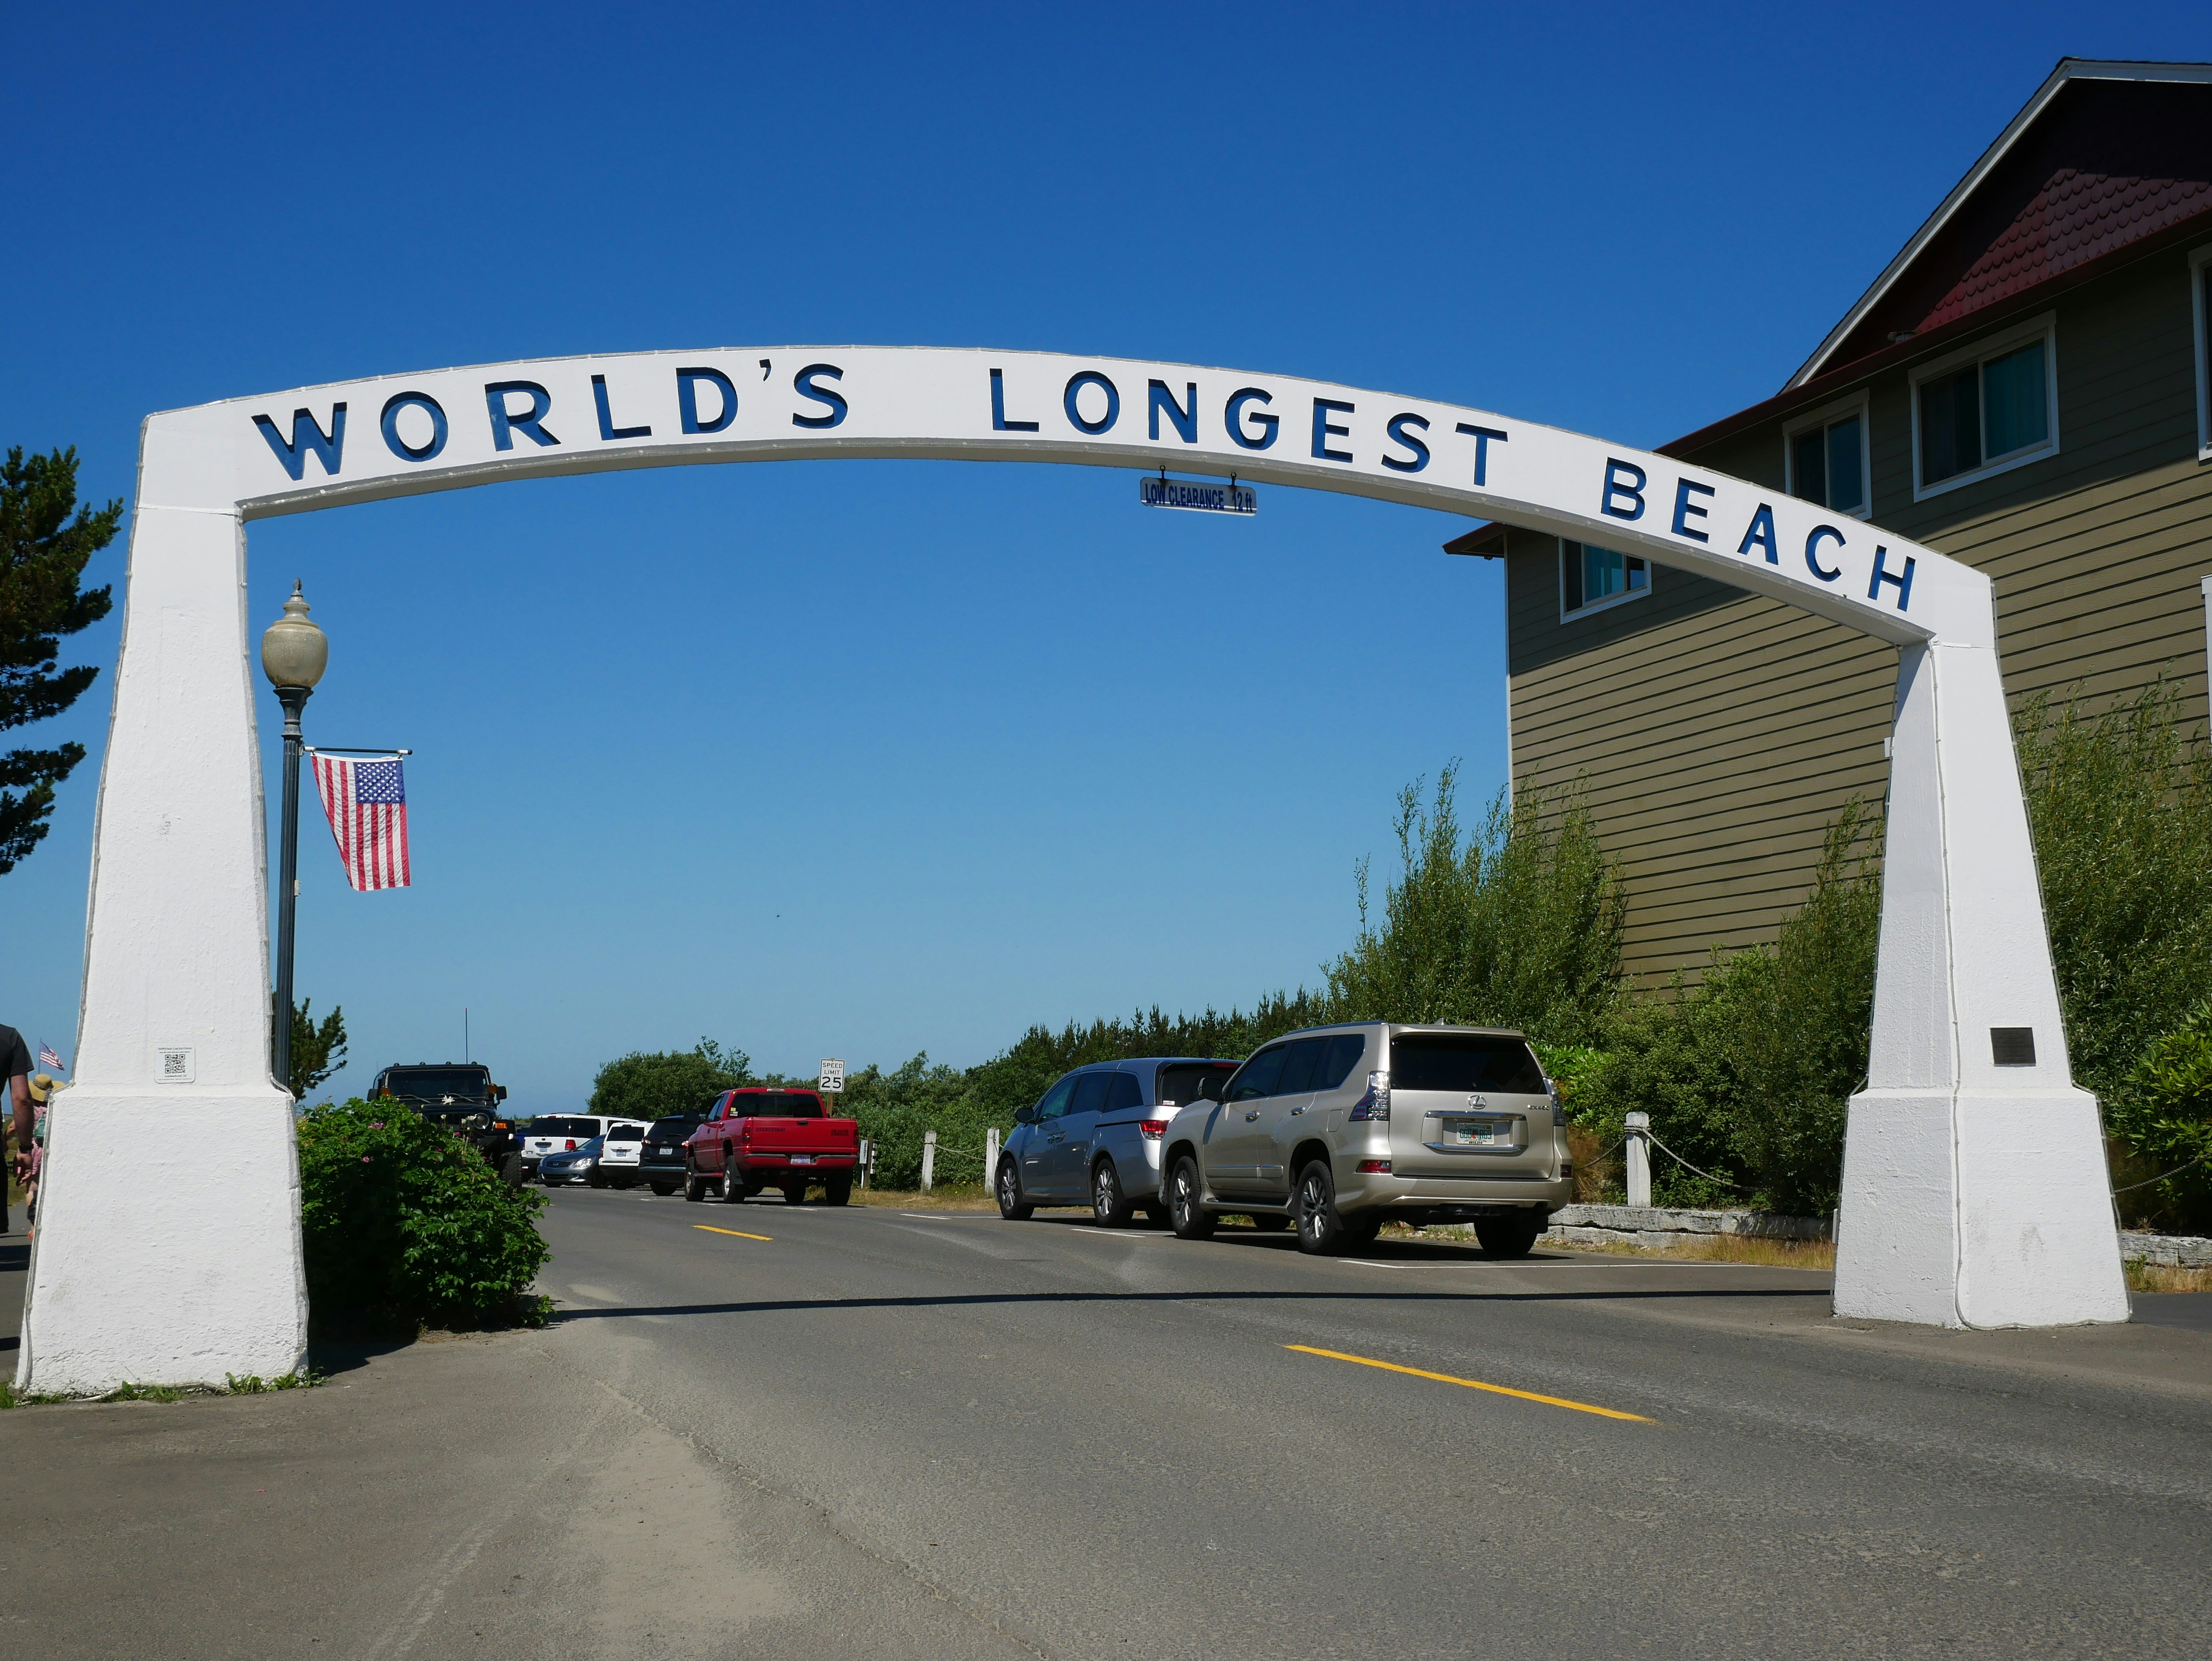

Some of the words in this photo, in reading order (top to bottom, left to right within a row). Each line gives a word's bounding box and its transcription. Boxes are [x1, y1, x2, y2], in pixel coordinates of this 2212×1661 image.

[250, 357, 849, 481] WORLD'S
[989, 367, 1509, 487] LONGEST
[1600, 456, 1917, 613] BEACH
[1145, 483, 1165, 504] LOW
[1168, 485, 1224, 510] CLEARANCE
[1232, 491, 1243, 512] 12
[821, 1076, 842, 1089] 25
